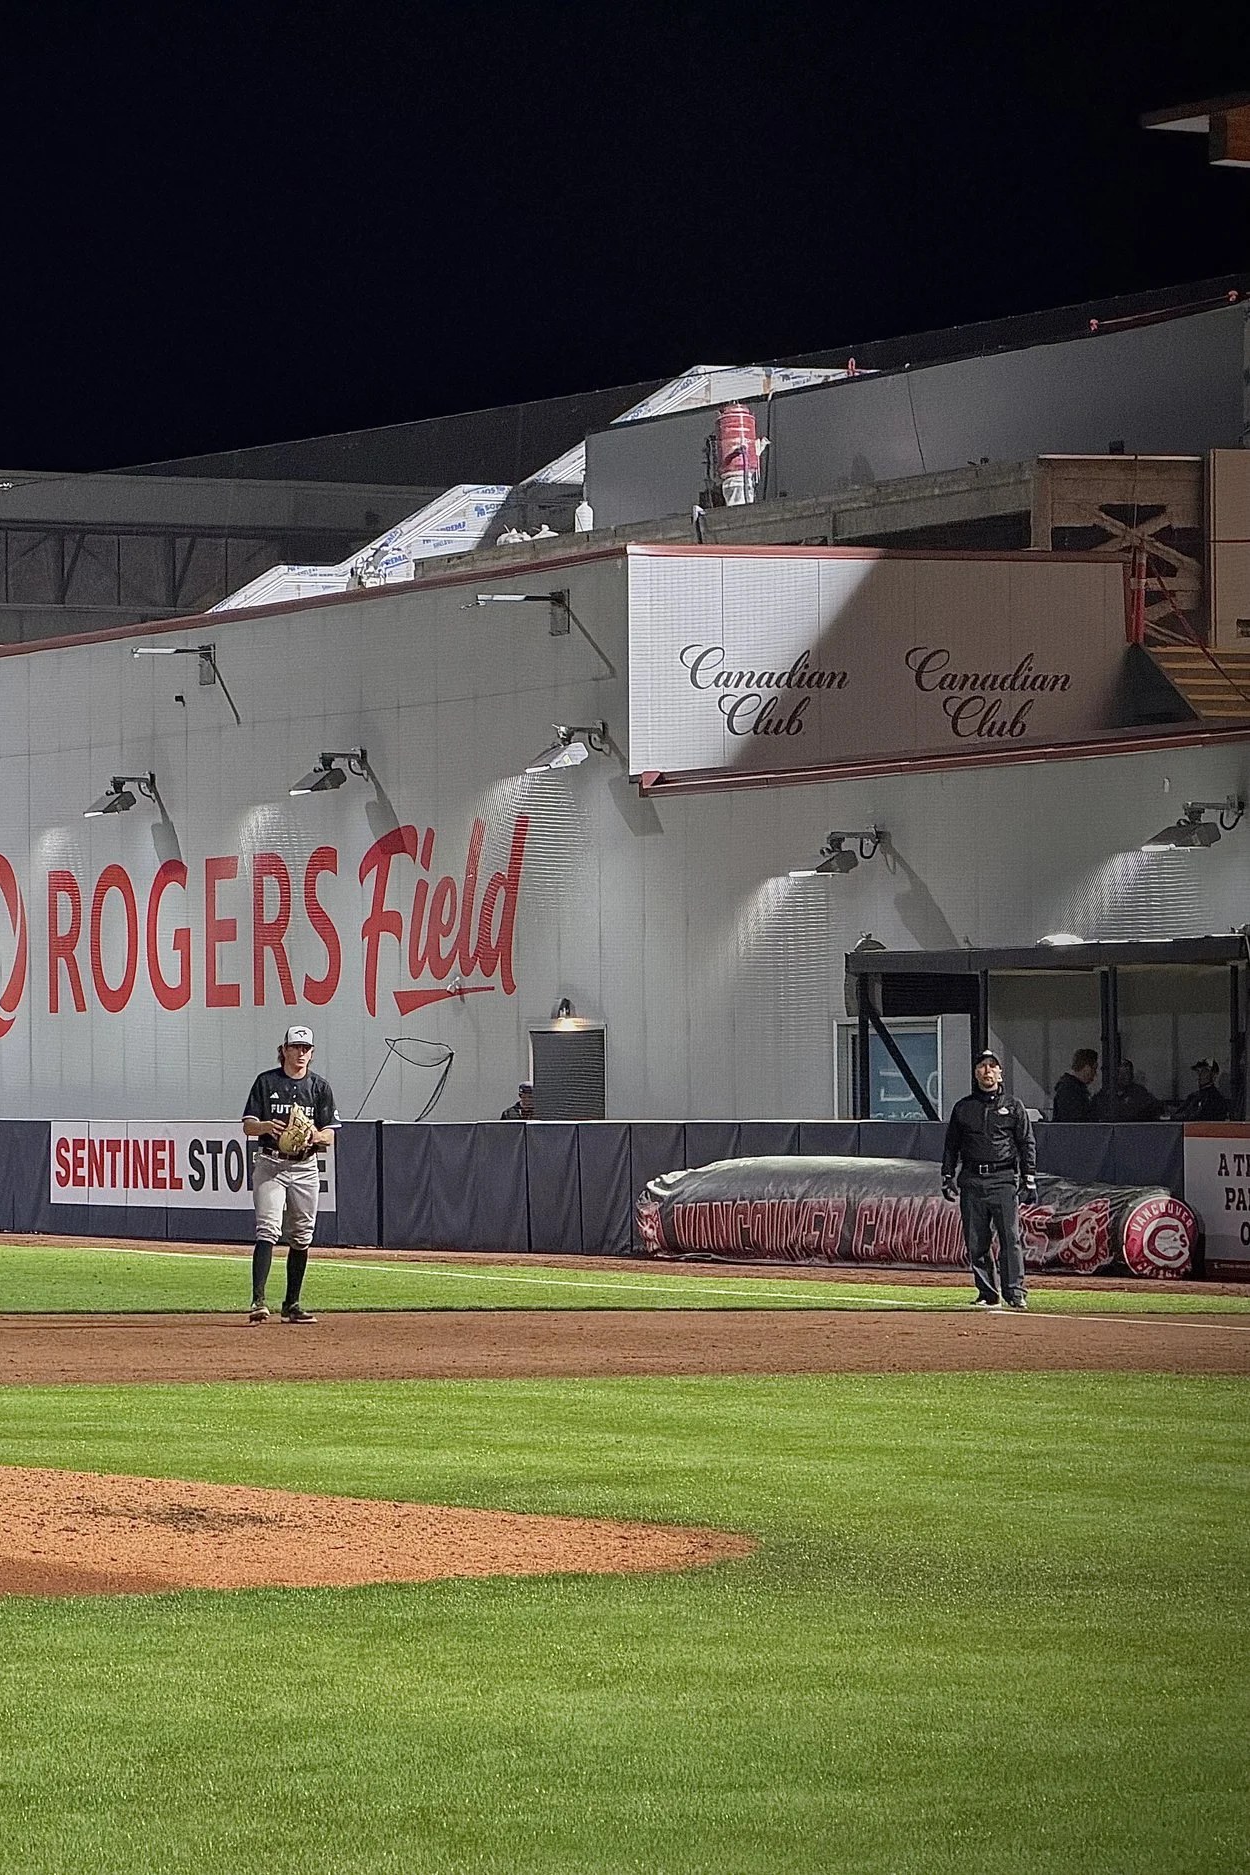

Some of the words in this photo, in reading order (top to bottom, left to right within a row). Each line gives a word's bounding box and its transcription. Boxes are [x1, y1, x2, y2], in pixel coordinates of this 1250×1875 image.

[679, 644, 849, 690] Canadian
[905, 646, 1071, 692] Canadian
[718, 693, 805, 736] Club
[942, 695, 1035, 738] Club
[49, 846, 342, 1014] ROGERS
[358, 815, 530, 1018] Field
[55, 1137, 183, 1190] SENTINEL
[1131, 1202, 1194, 1232] VANCOUVER
[1224, 1187, 1250, 1211] PA
